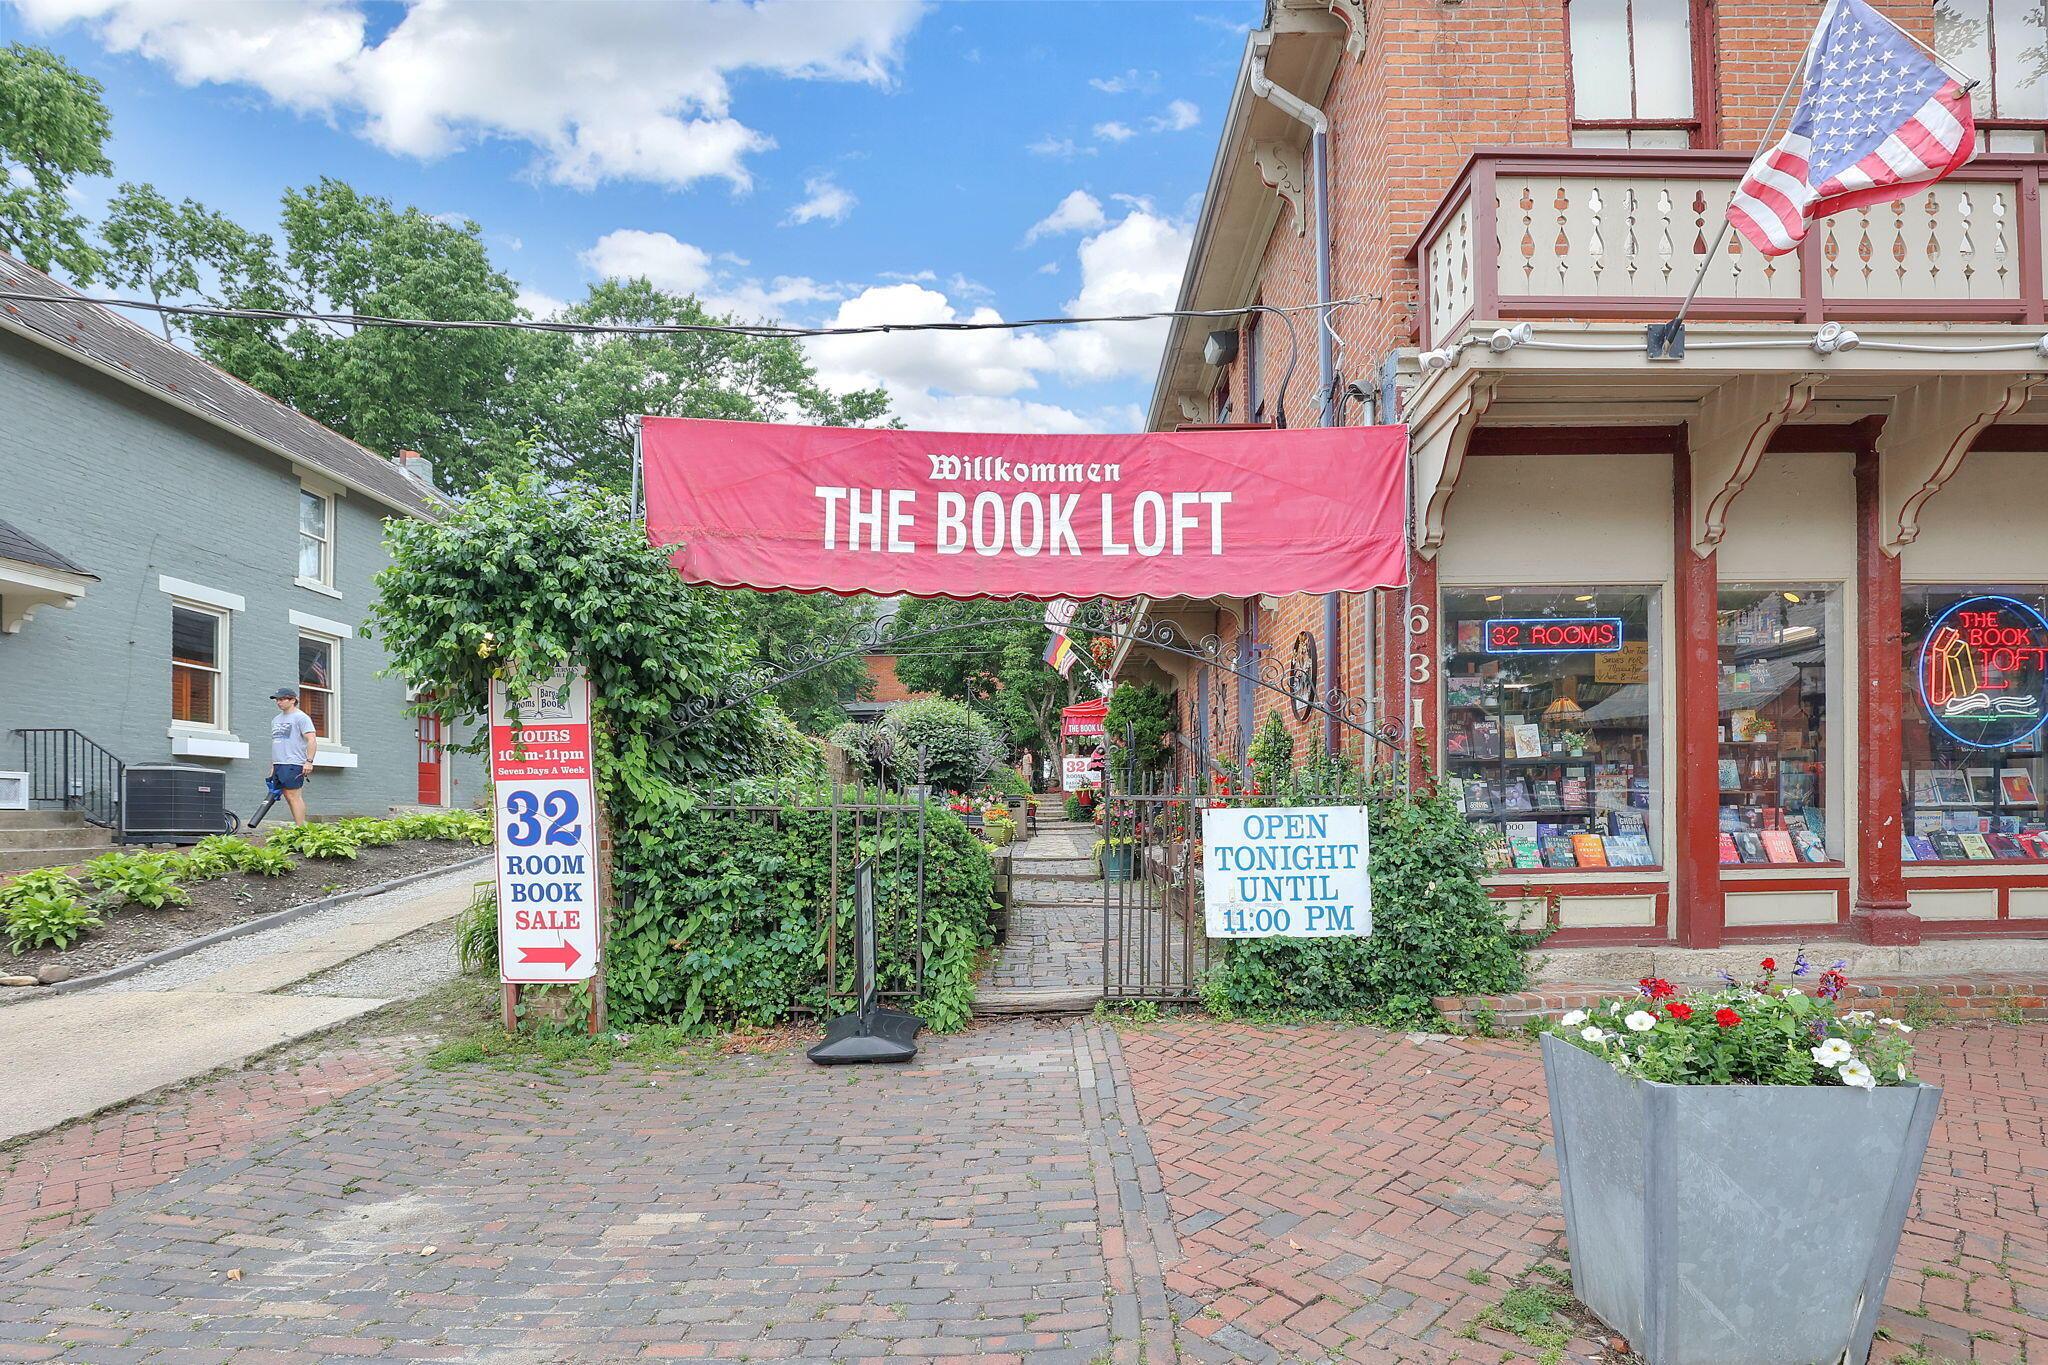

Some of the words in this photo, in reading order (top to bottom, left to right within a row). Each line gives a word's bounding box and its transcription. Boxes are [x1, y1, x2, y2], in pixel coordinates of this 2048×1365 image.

[928, 453, 1121, 484] Willkommen
[814, 485, 917, 553] THE
[937, 491, 1082, 557] BOOK
[1101, 490, 1234, 557] LOFT
[1958, 611, 1999, 628] THE
[1491, 626, 1520, 646] 32
[1532, 625, 1615, 645] ROOMS
[1970, 627, 2031, 646] BOOK
[1977, 647, 2048, 689] LOFT
[1068, 724, 1080, 732] THE
[1080, 724, 1096, 732] BOOK
[498, 749, 585, 763] 10m-11pm
[1066, 760, 1086, 773] 32
[498, 767, 525, 776] Seven
[527, 767, 549, 776] Days
[561, 766, 585, 774] Week
[506, 789, 582, 847] 32
[1243, 813, 1329, 840] OPEN
[1547, 841, 1570, 849] KING
[506, 855, 585, 876] ROOM
[1214, 844, 1359, 871] TONIGHT
[510, 882, 583, 903] BOOK
[1237, 875, 1339, 903] UNTIL
[515, 910, 581, 931] SALE
[1223, 908, 1291, 932] 11:00
[1304, 905, 1356, 931] PM
